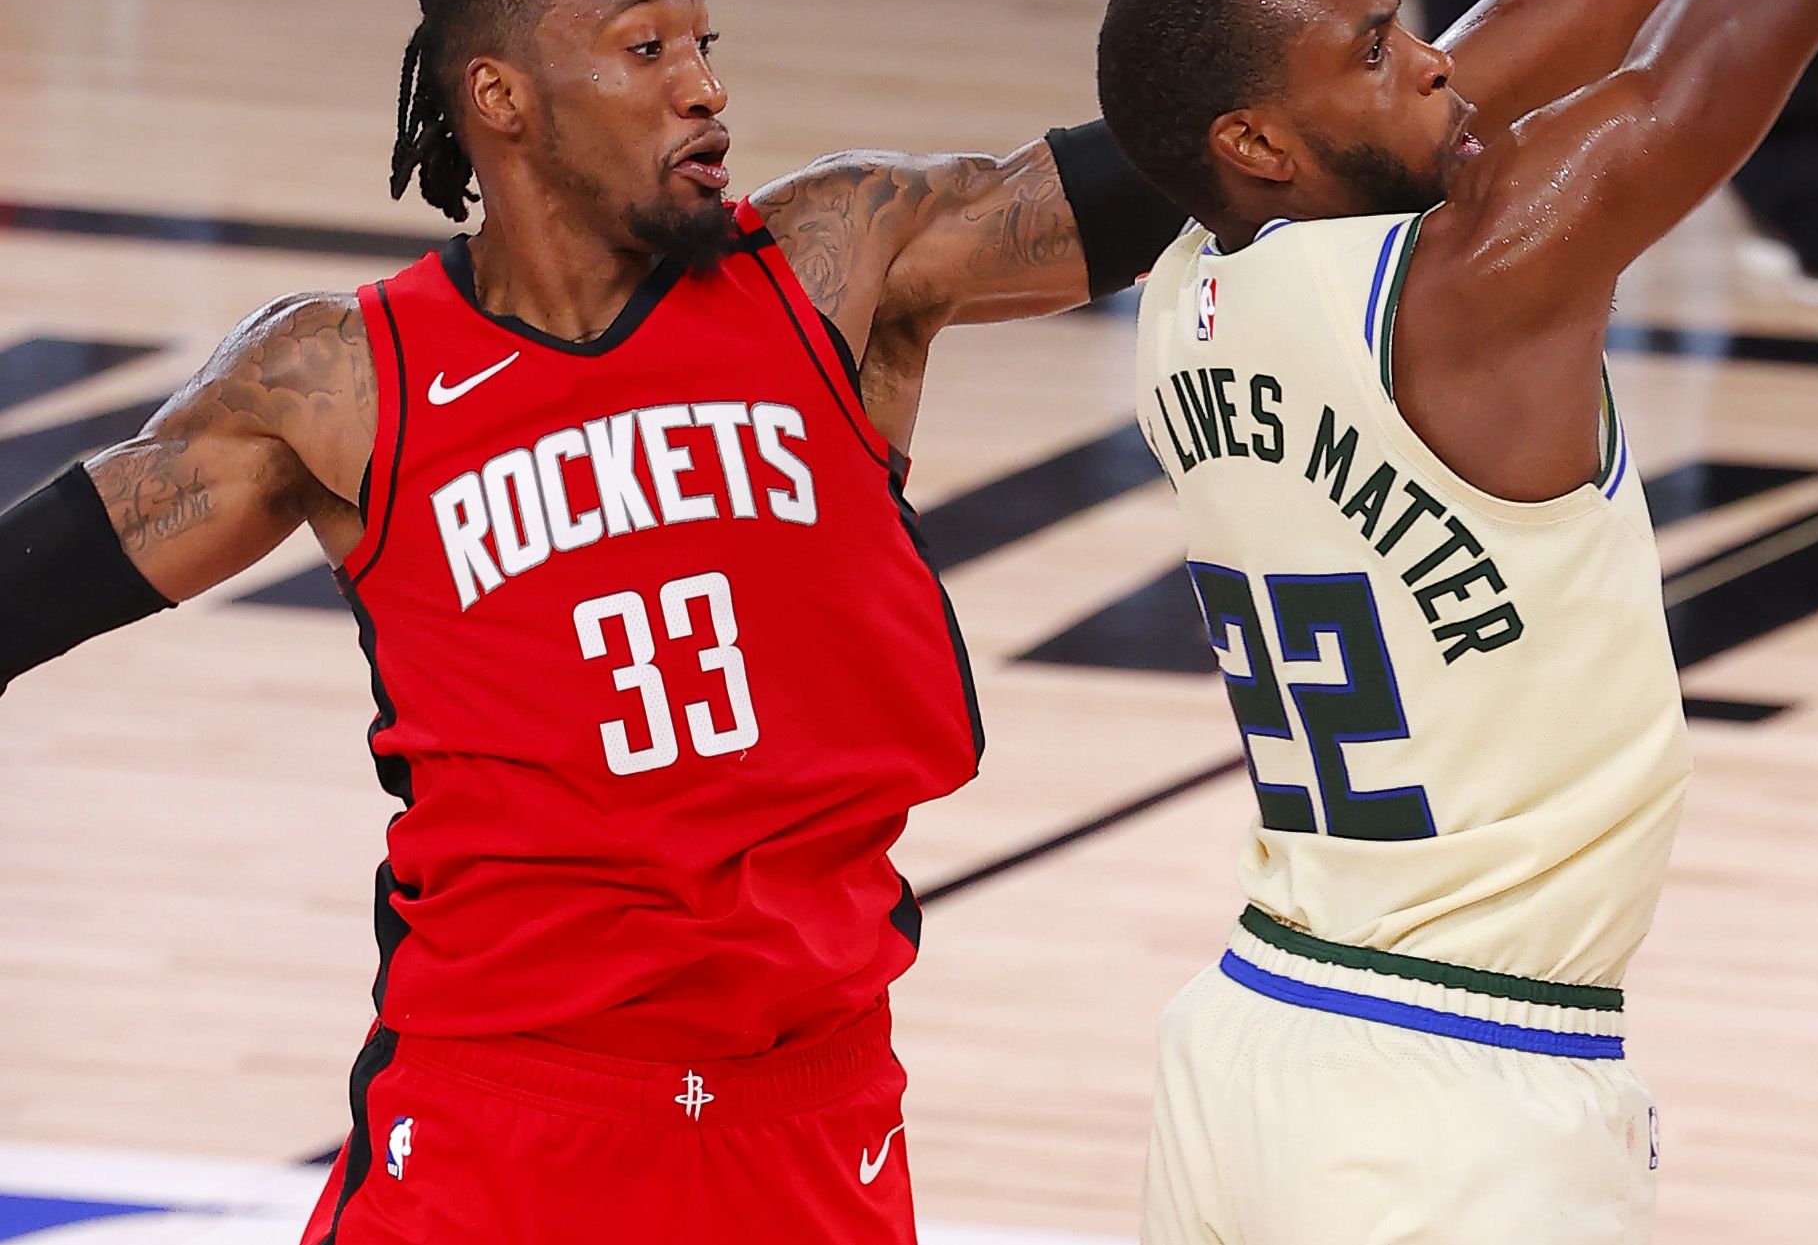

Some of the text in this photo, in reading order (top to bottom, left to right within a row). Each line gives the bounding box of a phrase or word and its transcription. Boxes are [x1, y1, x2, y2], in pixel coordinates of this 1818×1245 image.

[430, 401, 818, 613] ROCKETS
[1155, 367, 1284, 474] LIVES
[1303, 404, 1524, 665] MATTER
[572, 571, 760, 776] 33
[1184, 559, 1438, 842] 22
